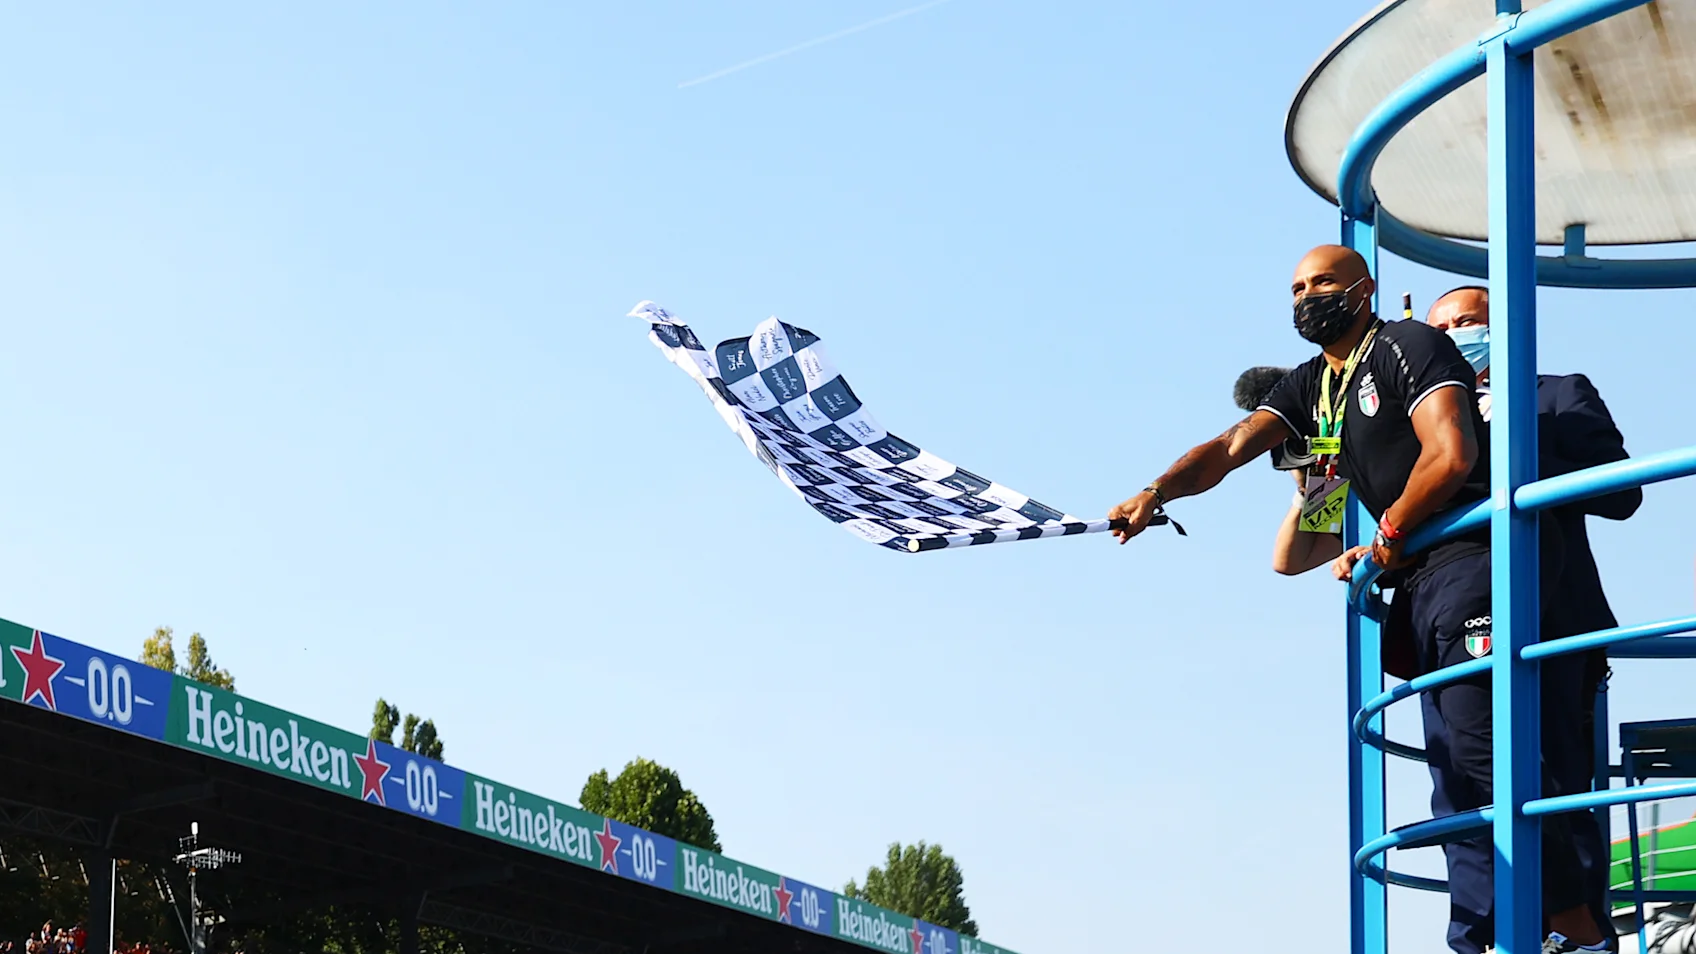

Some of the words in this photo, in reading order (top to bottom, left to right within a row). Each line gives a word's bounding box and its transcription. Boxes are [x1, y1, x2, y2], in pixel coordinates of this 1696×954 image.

[185, 685, 351, 789] Heineken
[474, 781, 593, 861] Heineken
[681, 848, 772, 914] Heineken
[837, 898, 908, 949] Heineken
